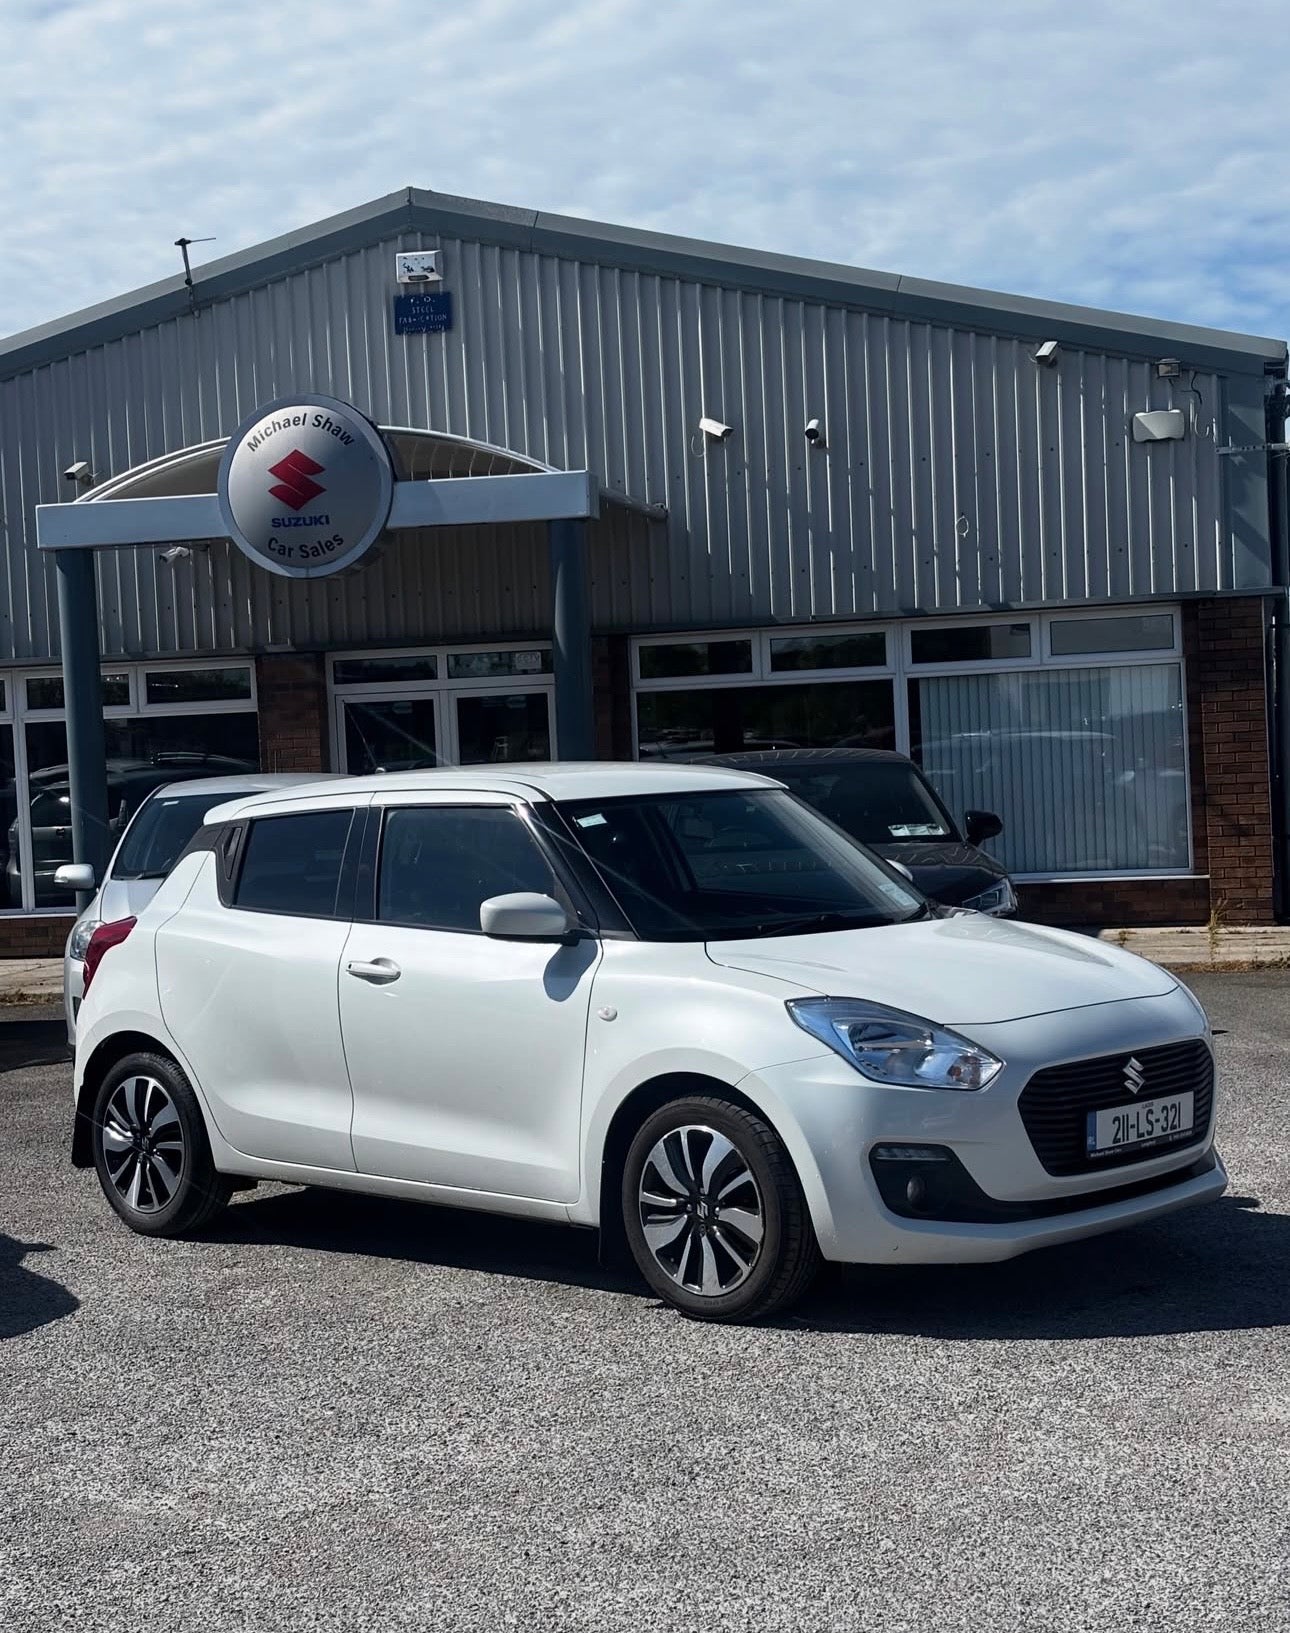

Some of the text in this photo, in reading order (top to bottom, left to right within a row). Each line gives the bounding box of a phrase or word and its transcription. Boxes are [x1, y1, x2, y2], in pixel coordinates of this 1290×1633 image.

[247, 412, 354, 452] Michael Shaw
[271, 515, 330, 528] SUZUKI
[267, 533, 344, 559] Car Sales
[1112, 1102, 1181, 1145] 211-LS-321
